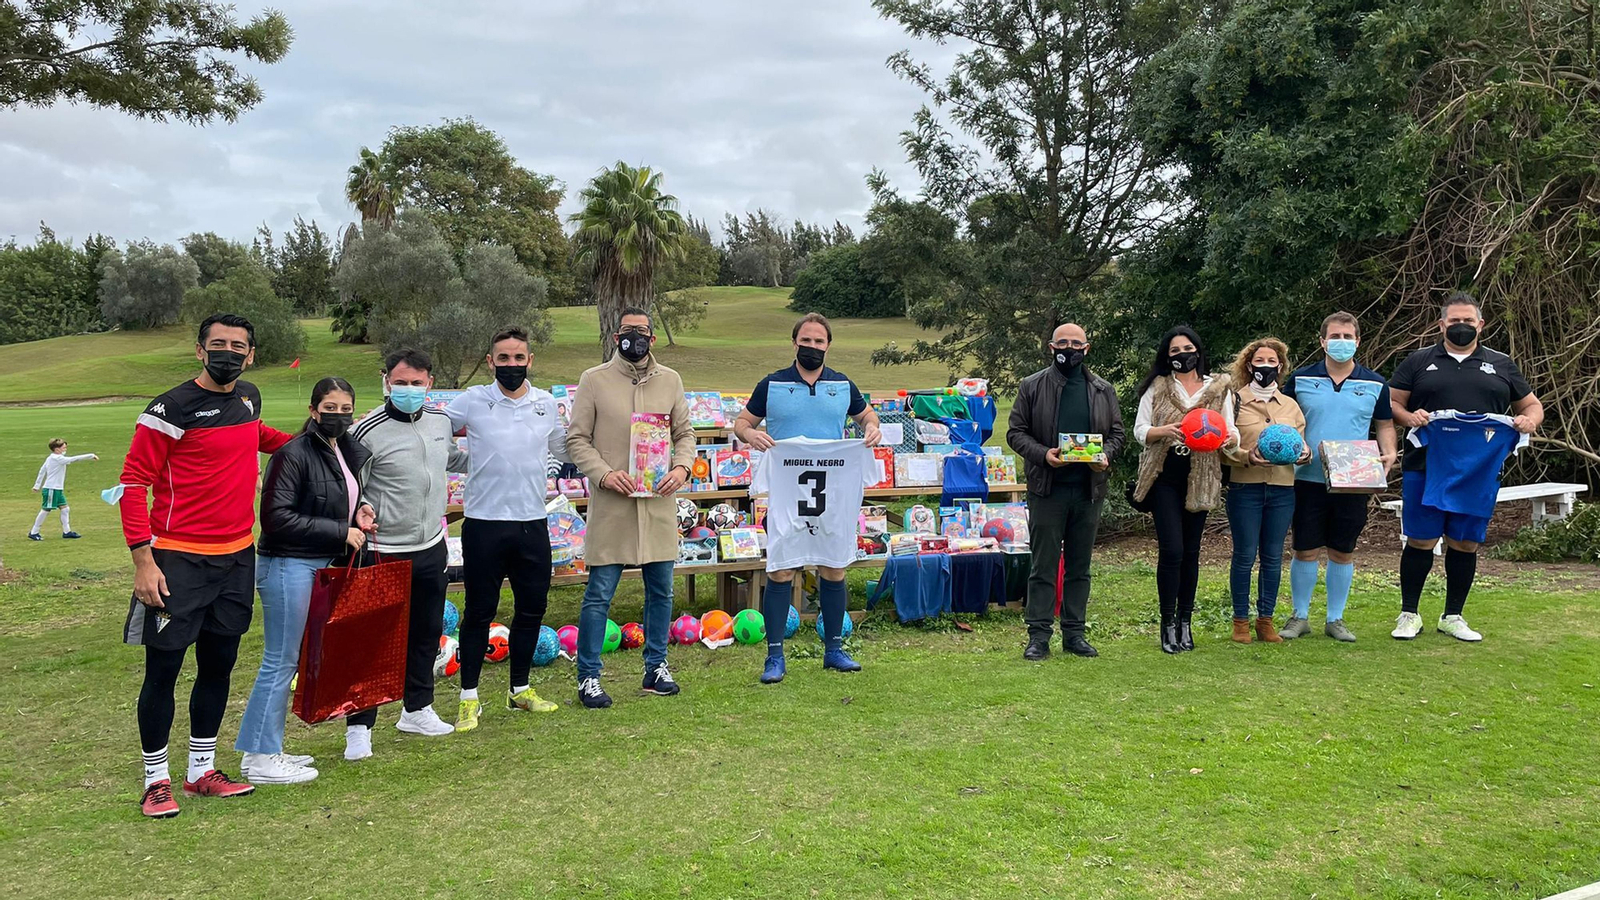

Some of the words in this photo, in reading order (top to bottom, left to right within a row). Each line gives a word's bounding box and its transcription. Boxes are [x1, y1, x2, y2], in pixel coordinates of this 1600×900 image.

[783, 459, 814, 467] MIGUEL
[816, 459, 845, 467] NEGRO
[798, 470, 827, 517] 3
